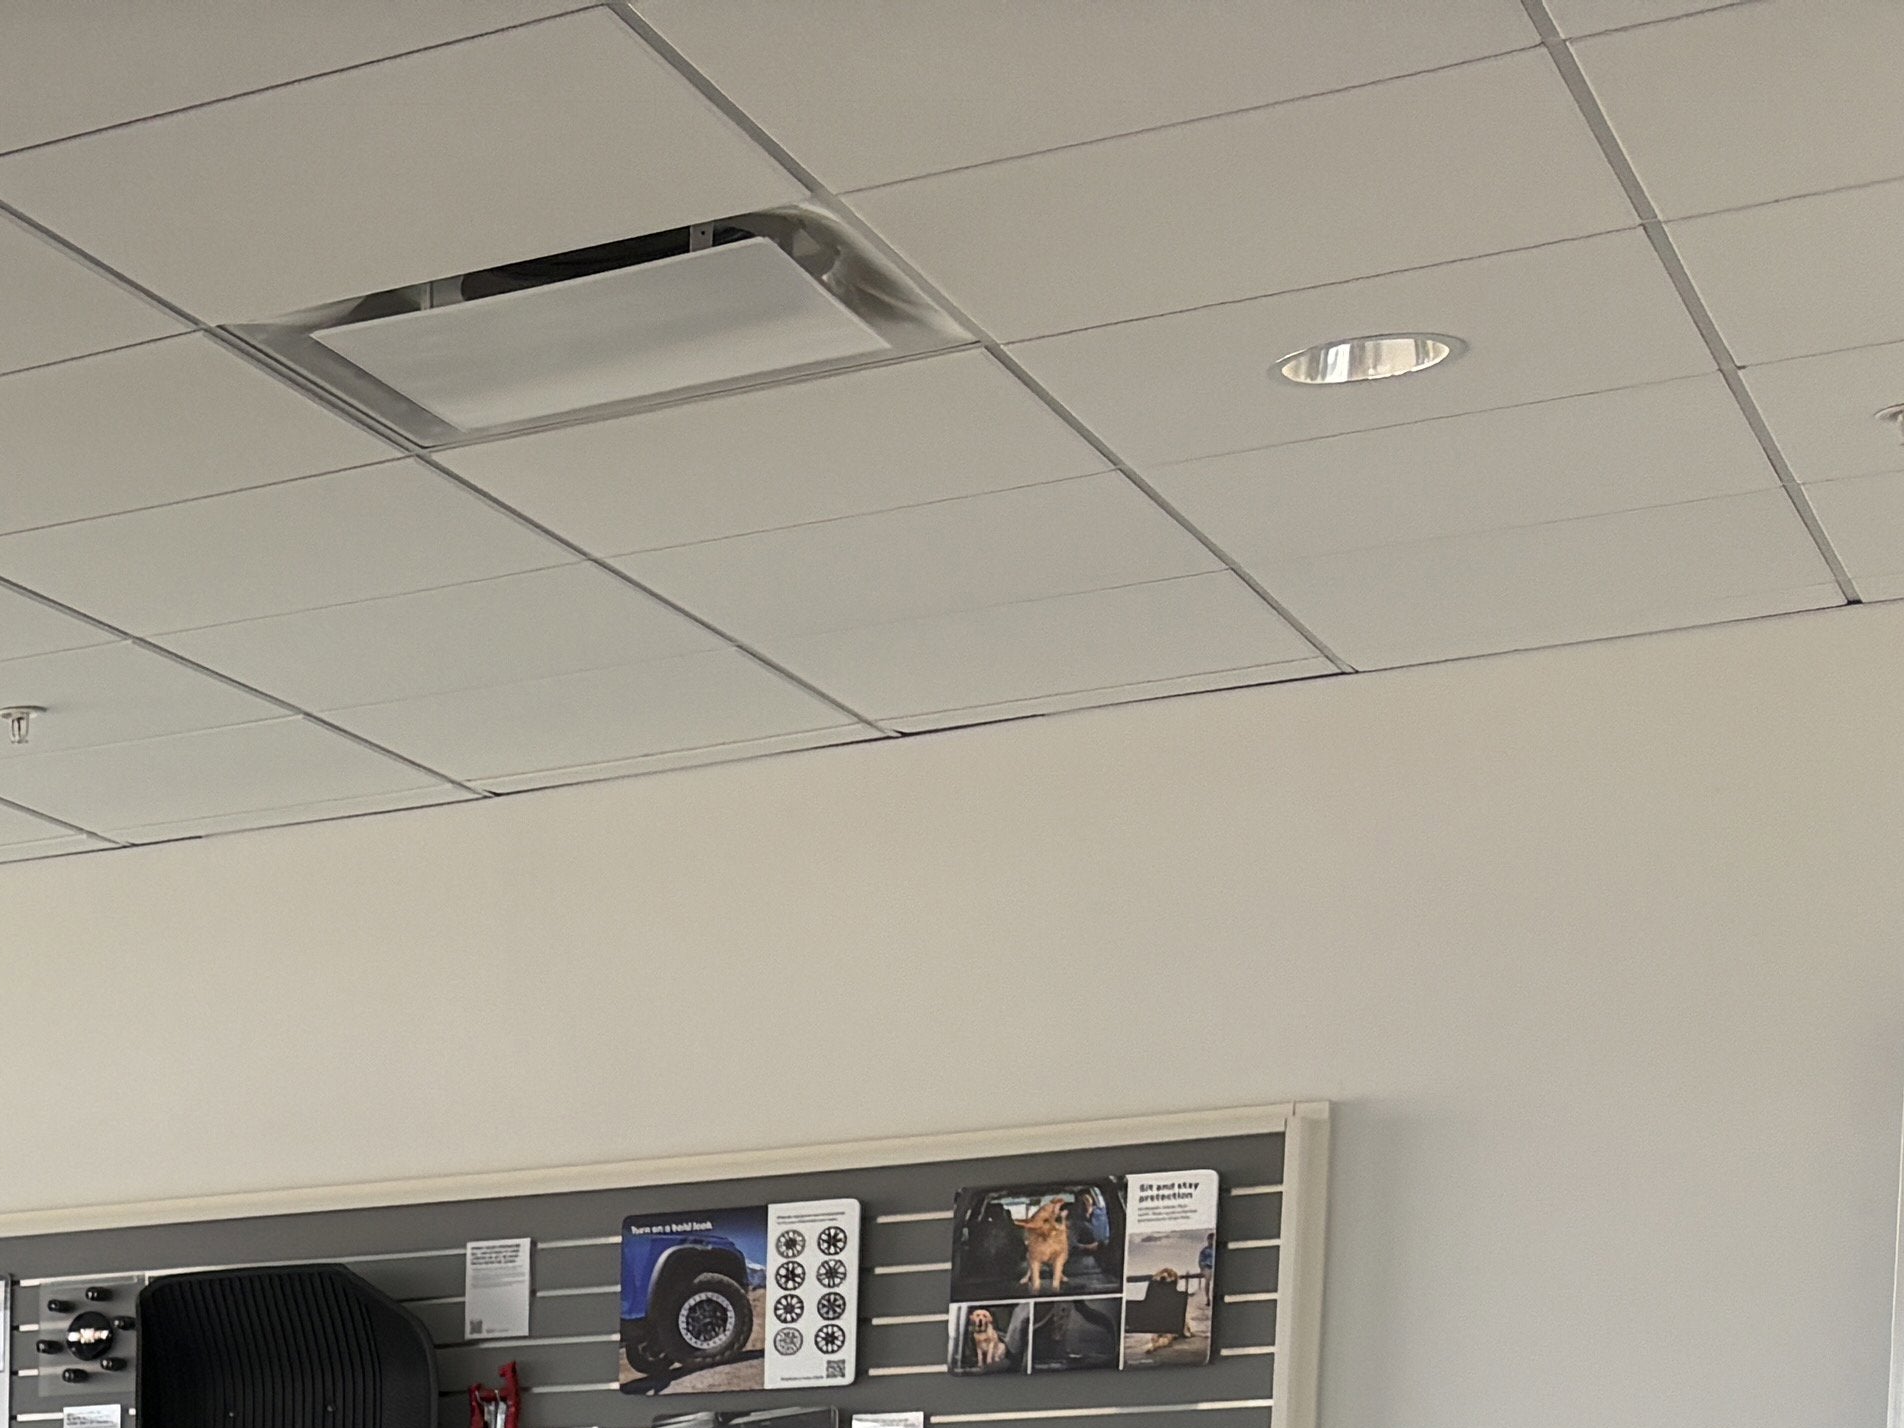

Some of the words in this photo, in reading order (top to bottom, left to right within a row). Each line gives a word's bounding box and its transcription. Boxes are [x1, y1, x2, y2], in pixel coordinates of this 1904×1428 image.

[1156, 1182, 1175, 1191] and
[1178, 1181, 1199, 1191] stay
[1138, 1191, 1193, 1203] protection
[631, 1226, 650, 1235] Turn
[652, 1225, 663, 1234] on
[672, 1222, 692, 1233] bold
[693, 1220, 713, 1231] look
